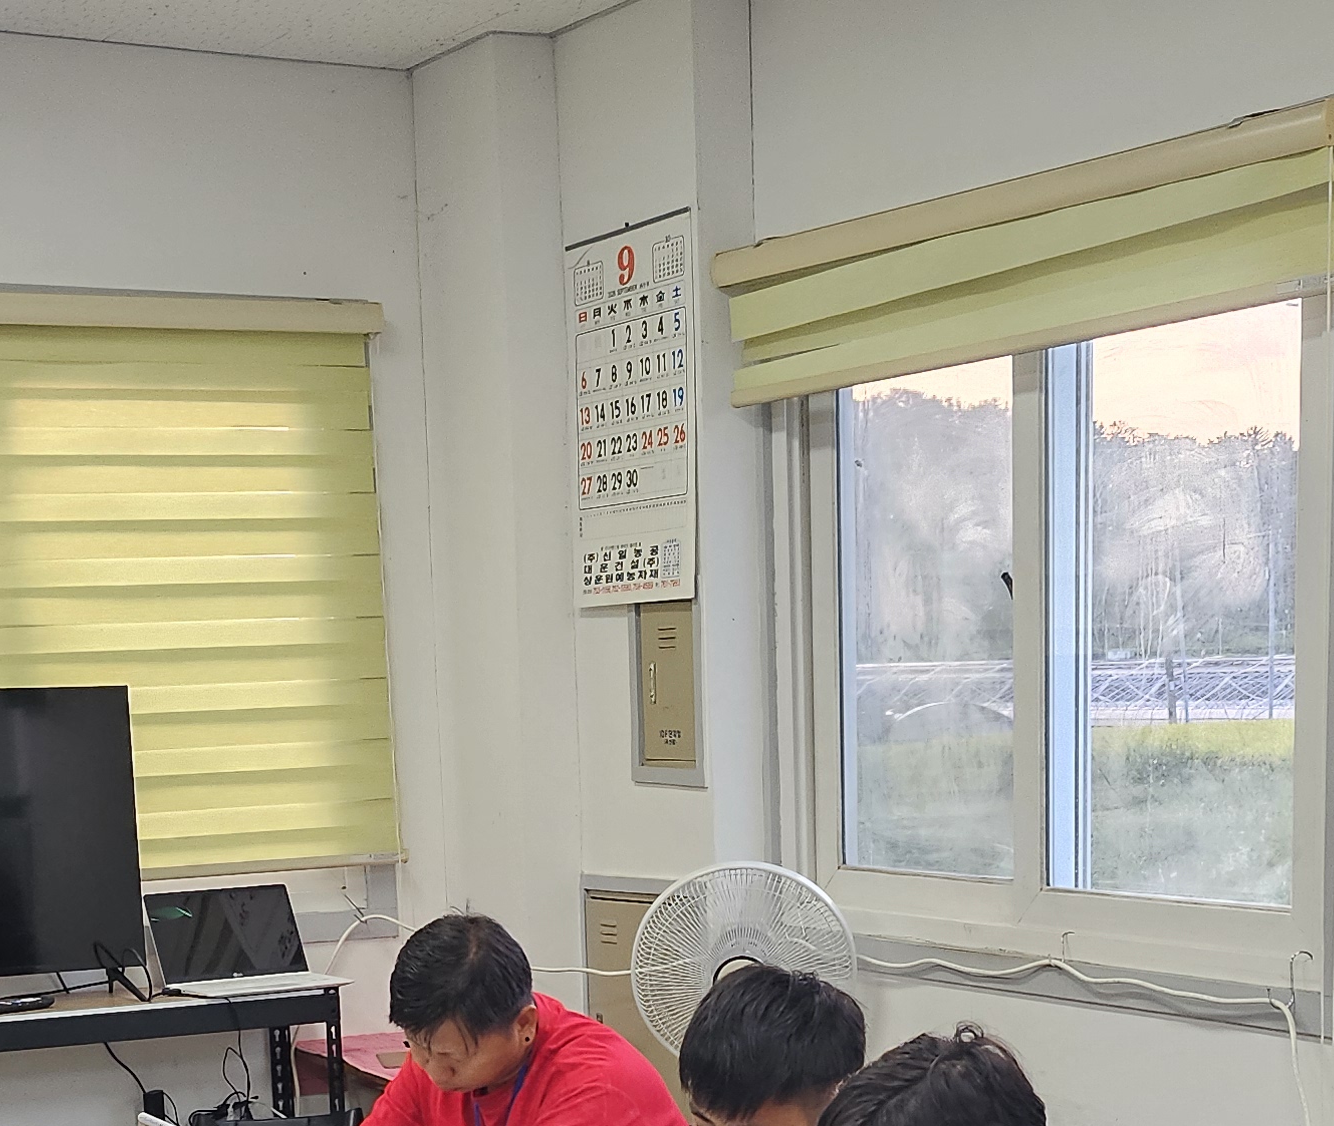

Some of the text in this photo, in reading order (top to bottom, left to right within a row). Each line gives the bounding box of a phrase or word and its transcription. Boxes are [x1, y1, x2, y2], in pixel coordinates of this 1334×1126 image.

[618, 245, 635, 286] 9
[579, 312, 588, 324] 日
[608, 303, 617, 316] 火
[672, 286, 681, 299] 土
[611, 312, 681, 347] 1 2 3 4 5
[581, 349, 684, 389] 6 7 8 9 10 11 12
[580, 387, 684, 426] 13 14 15 16 17 18 19
[580, 423, 686, 461] 20 21 22 23 24 25 26
[581, 469, 638, 496] 27 28 29 30
[584, 552, 599, 564] (주)
[643, 557, 659, 568] (주)
